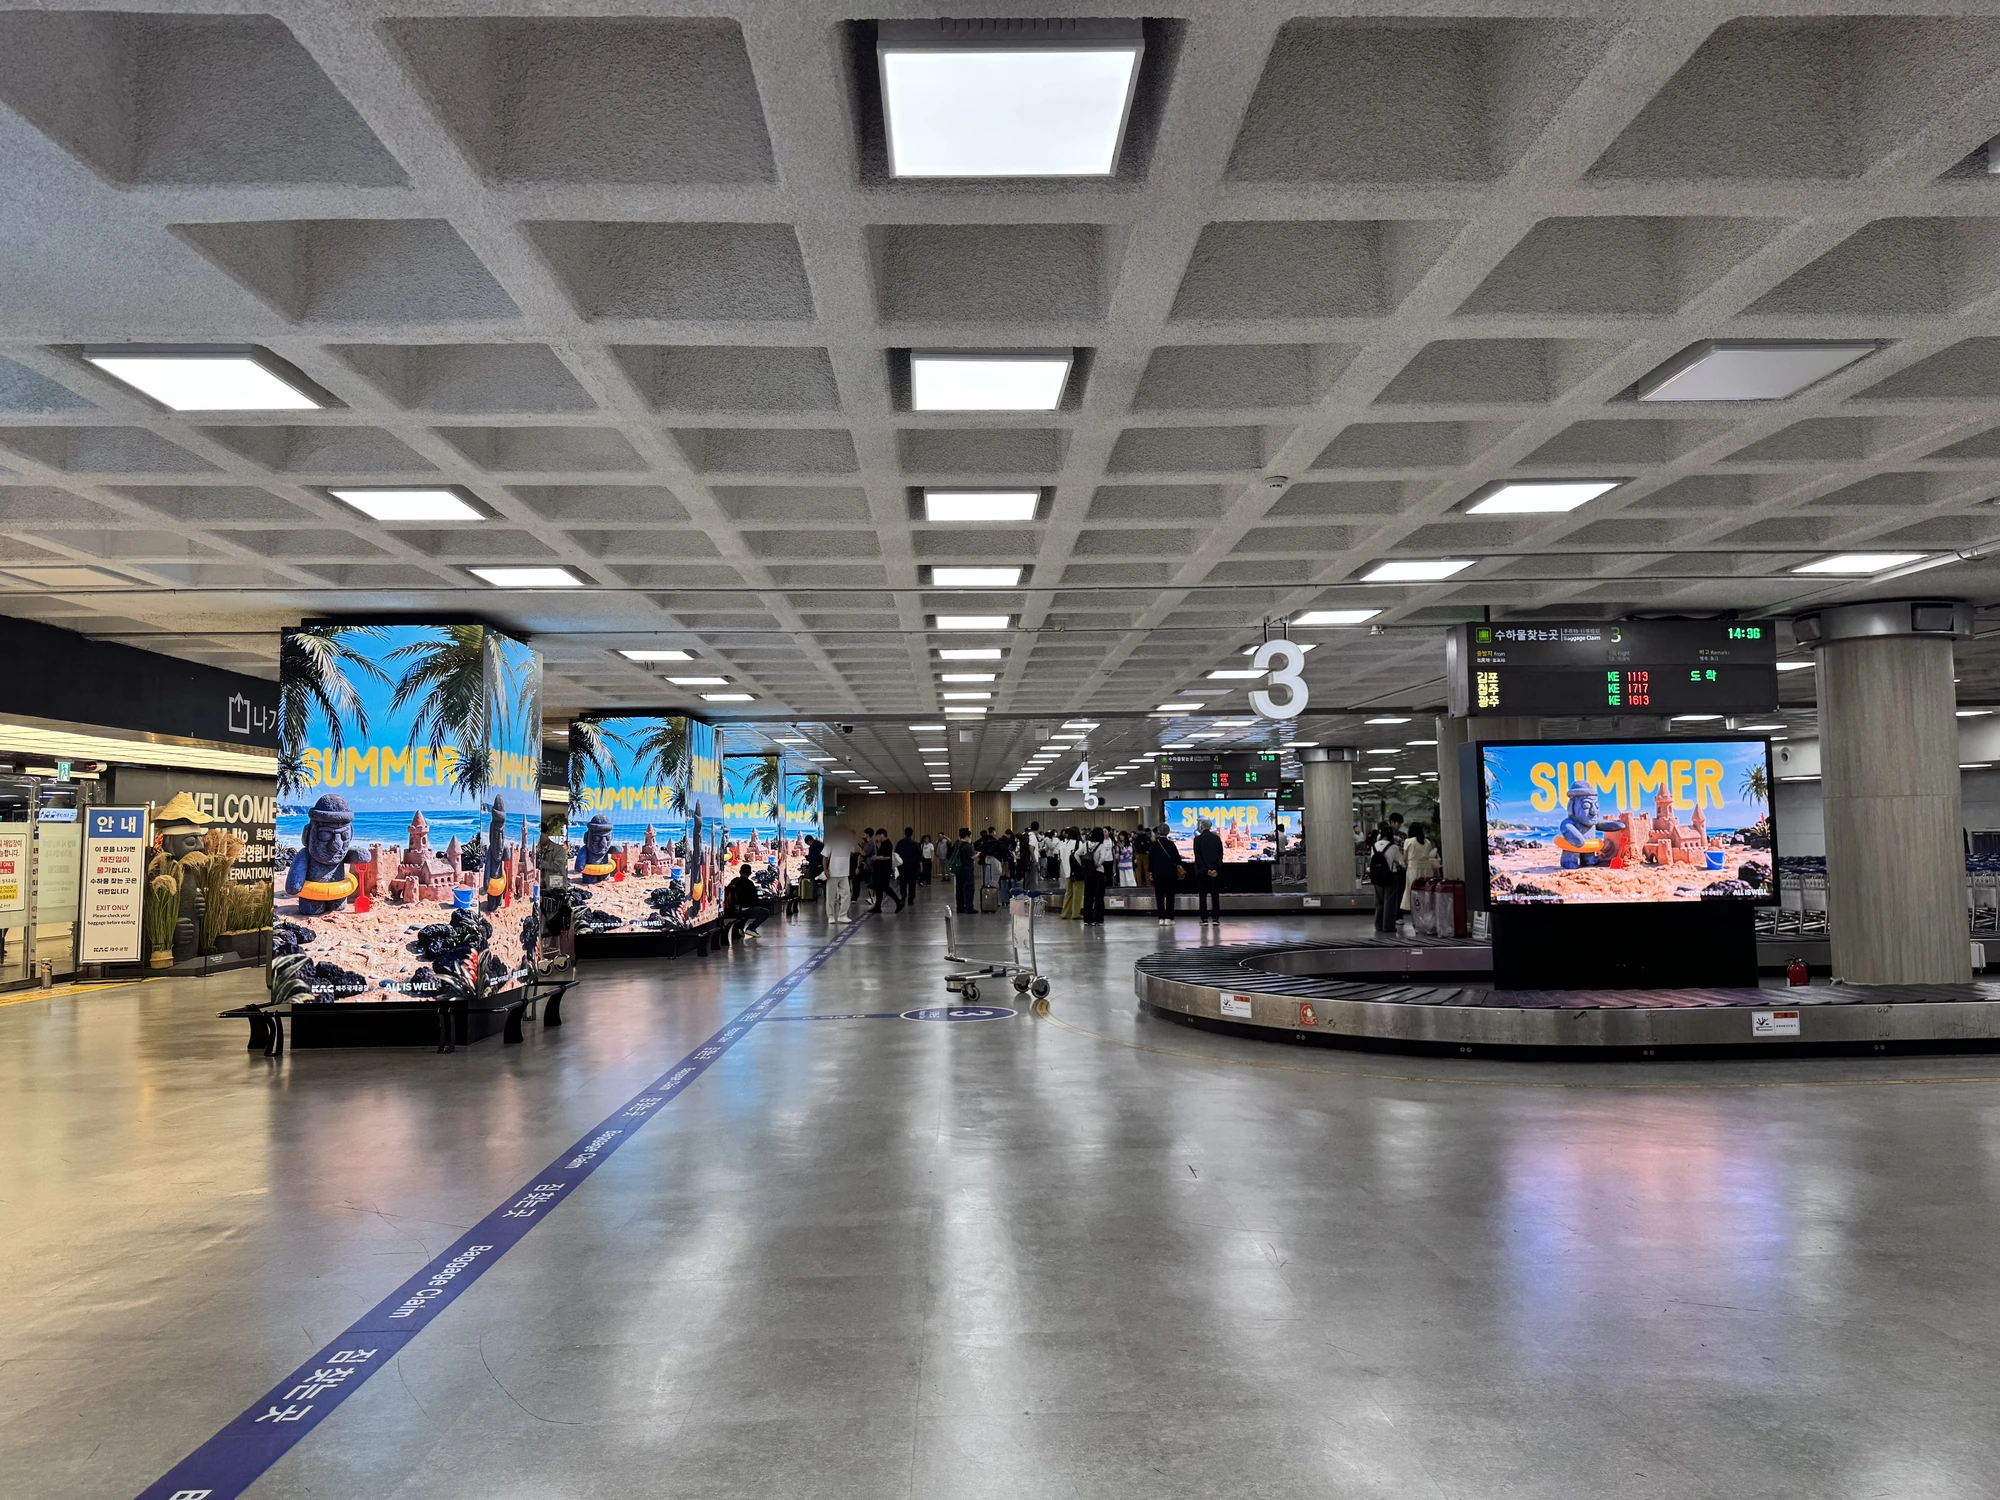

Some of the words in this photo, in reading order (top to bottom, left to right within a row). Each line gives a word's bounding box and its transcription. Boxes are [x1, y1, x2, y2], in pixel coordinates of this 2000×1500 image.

[1495, 629, 1559, 641] 수하물찾는곳
[1611, 627, 1622, 643] 3
[1727, 627, 1761, 640] 14:36
[1249, 639, 1309, 720] 3
[1476, 671, 1499, 683] 김포
[1607, 671, 1620, 682] KE
[1627, 671, 1649, 682] 1113
[1608, 683, 1620, 693] KE
[1627, 683, 1649, 693] 1717
[1608, 695, 1621, 706] KE
[1628, 695, 1650, 706] 1613
[300, 746, 461, 788] SUMMER
[1069, 761, 1093, 794] 4
[1530, 759, 1725, 813] SUMMER
[581, 786, 674, 811] SUMMER
[1084, 789, 1099, 810] 5
[723, 802, 770, 819] MMER
[229, 867, 275, 880] ERNATIONA
[311, 984, 335, 993] KAC
[384, 982, 402, 992] ALL
[403, 982, 412, 991] IS
[413, 982, 438, 991] WELL
[428, 1244, 494, 1287] Baggage
[388, 1288, 444, 1319] Claim
